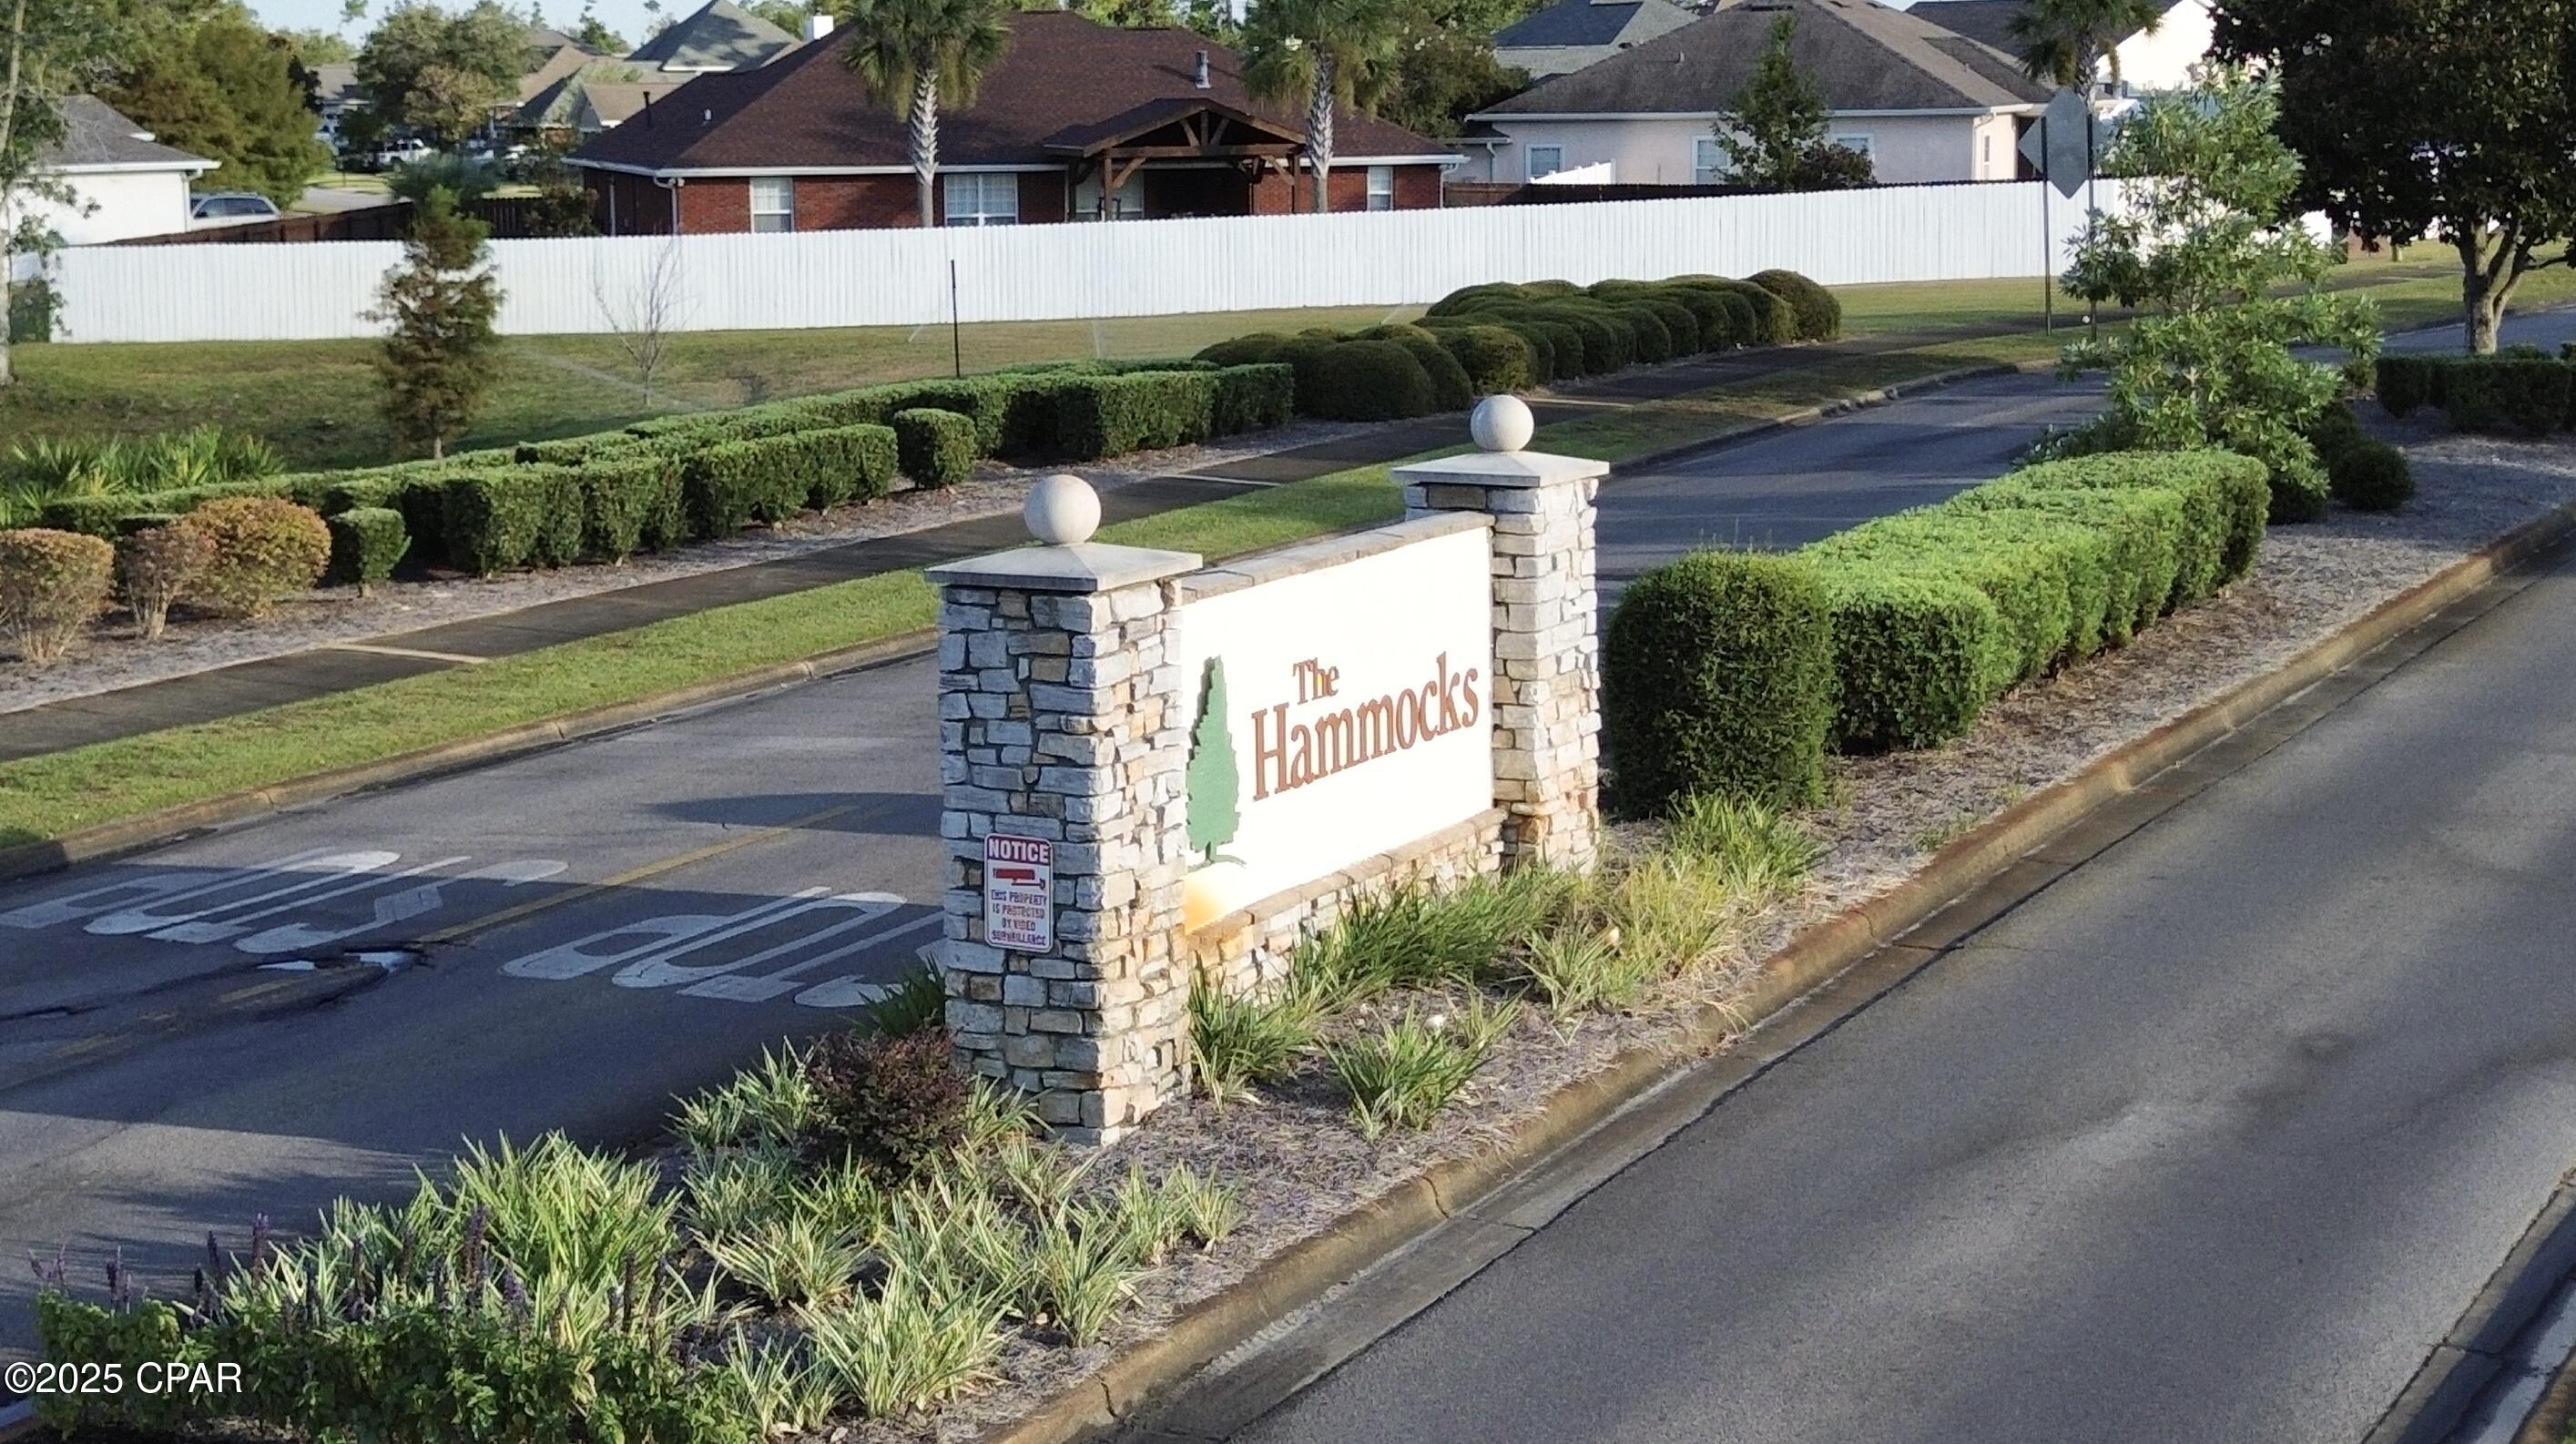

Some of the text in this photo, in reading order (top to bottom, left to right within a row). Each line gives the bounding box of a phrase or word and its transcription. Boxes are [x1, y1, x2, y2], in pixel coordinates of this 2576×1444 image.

[1292, 656, 1340, 706] The
[1250, 650, 1480, 802] Hammocks
[988, 838, 1050, 863] NOTICE
[991, 889, 1047, 906] THIS PROPERTY
[992, 902, 1045, 920] IS PROTECTED
[1002, 917, 1036, 931] BY VIDEO
